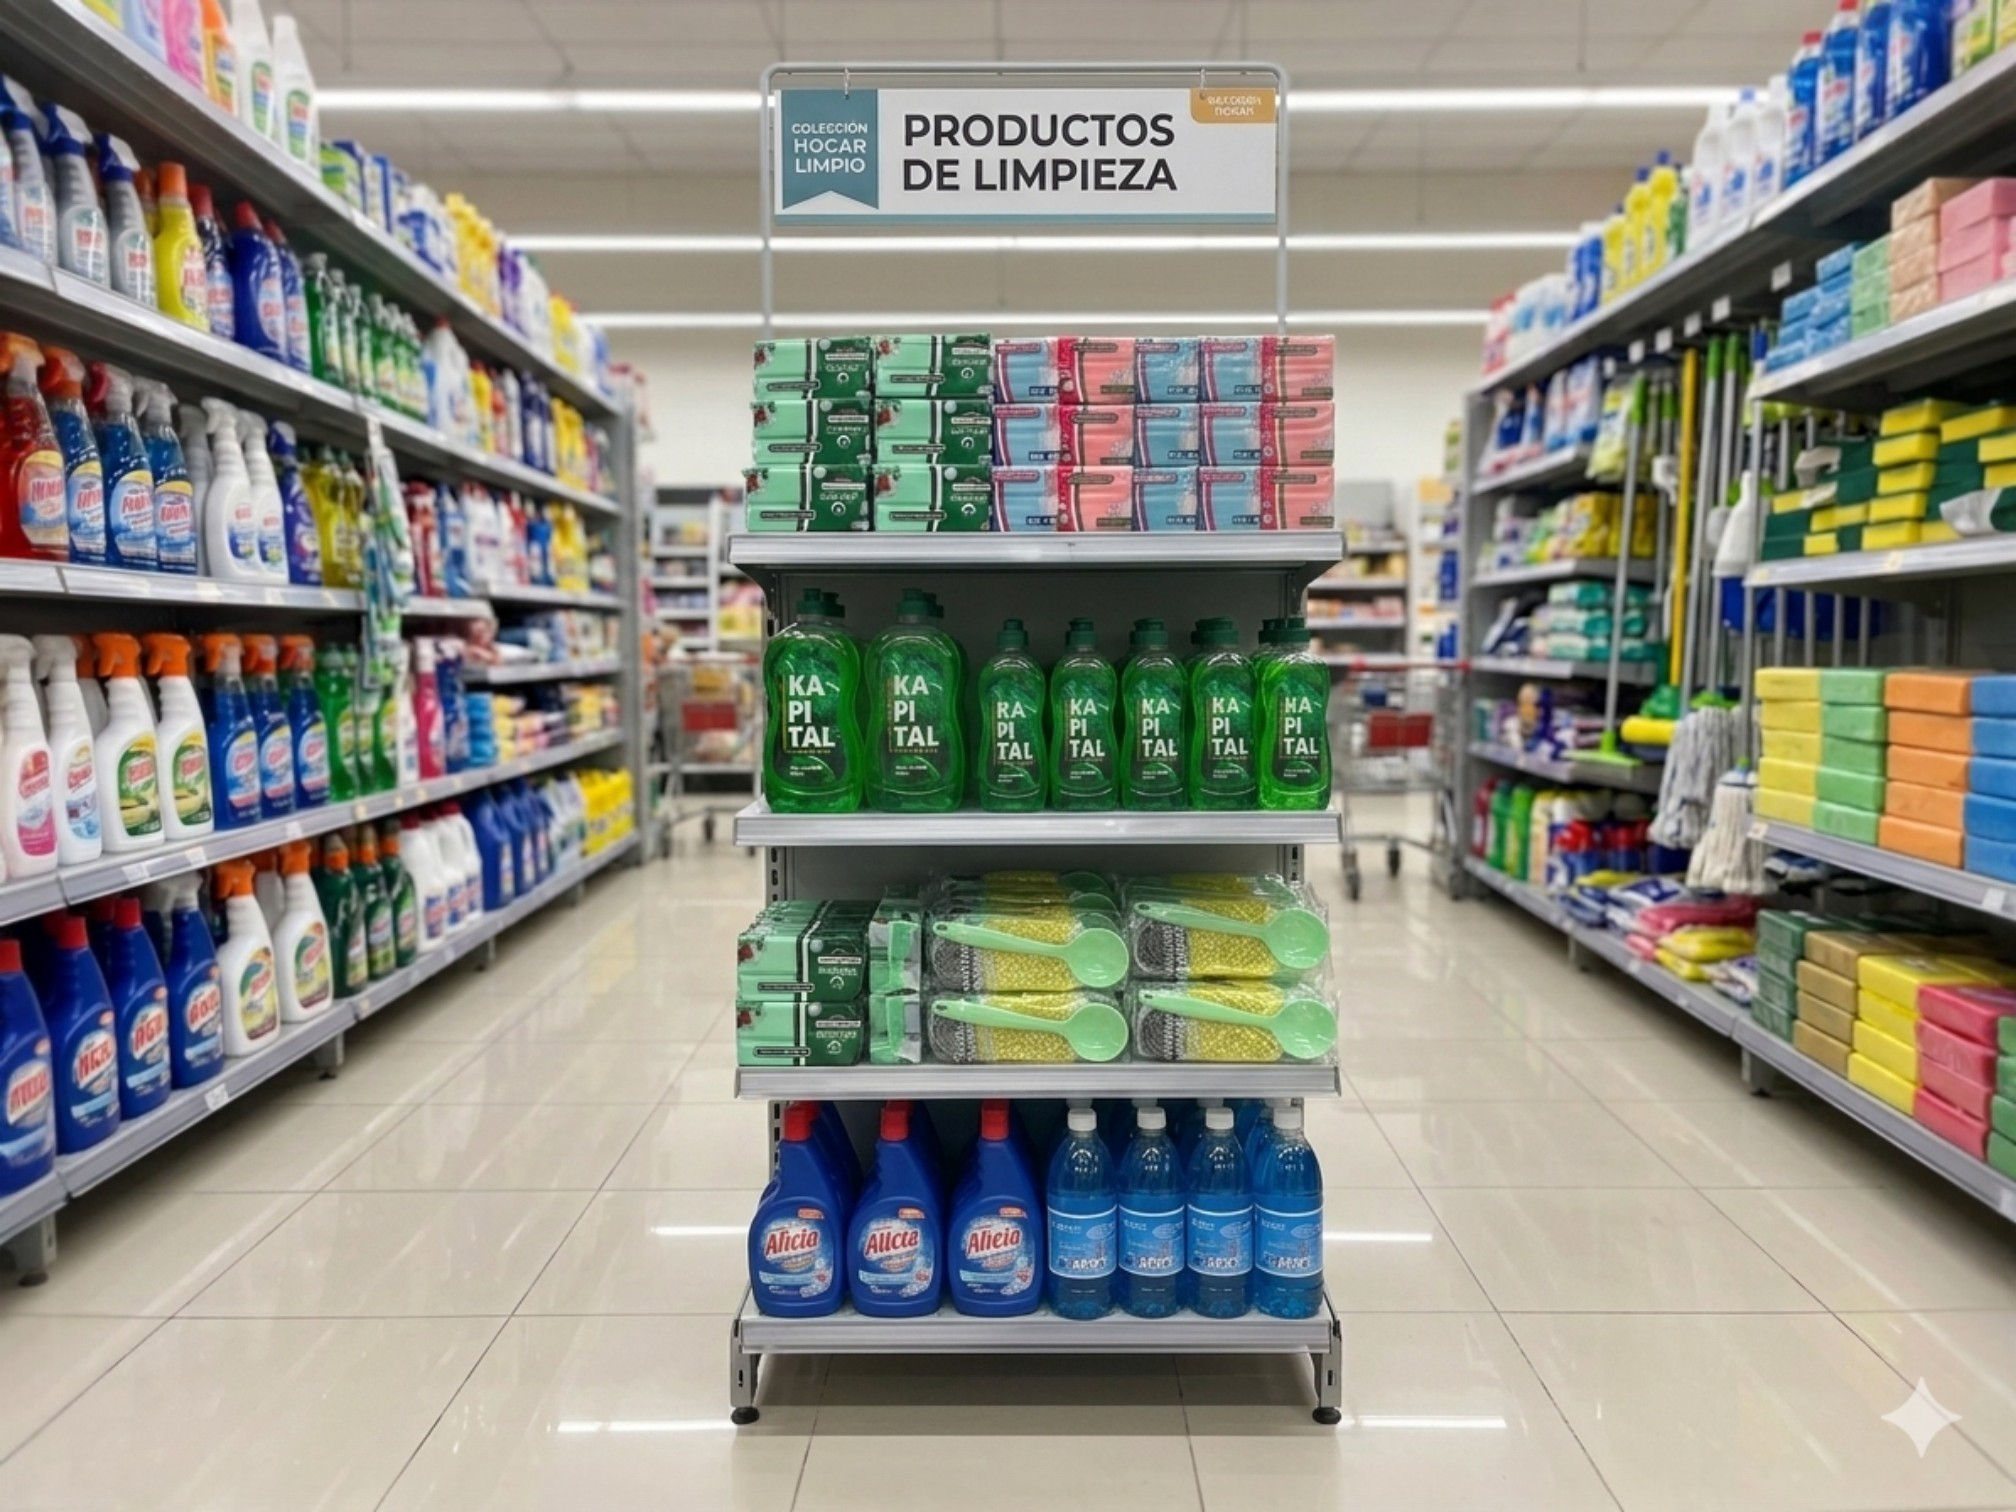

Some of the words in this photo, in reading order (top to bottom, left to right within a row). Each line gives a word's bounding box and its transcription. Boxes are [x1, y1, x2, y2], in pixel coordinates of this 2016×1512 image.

[904, 113, 1175, 147] PRODUCTOS
[795, 157, 866, 173] LIMPIO
[903, 158, 960, 191] DE
[975, 158, 1177, 191] LIMPIEZA
[788, 674, 826, 696] KA
[893, 674, 929, 696] KA
[788, 700, 812, 724] PI
[893, 700, 916, 723] PI
[1070, 718, 1087, 737] PI
[1142, 717, 1160, 737] PI
[1212, 716, 1230, 736] PI
[1284, 716, 1302, 735] PI
[788, 725, 836, 748] TAL
[893, 725, 940, 747] TAL
[1283, 737, 1319, 755] TAL
[996, 742, 1033, 760] TAL
[1069, 739, 1105, 757] TAL
[1142, 738, 1178, 757] TAL
[1211, 737, 1248, 756] TAL
